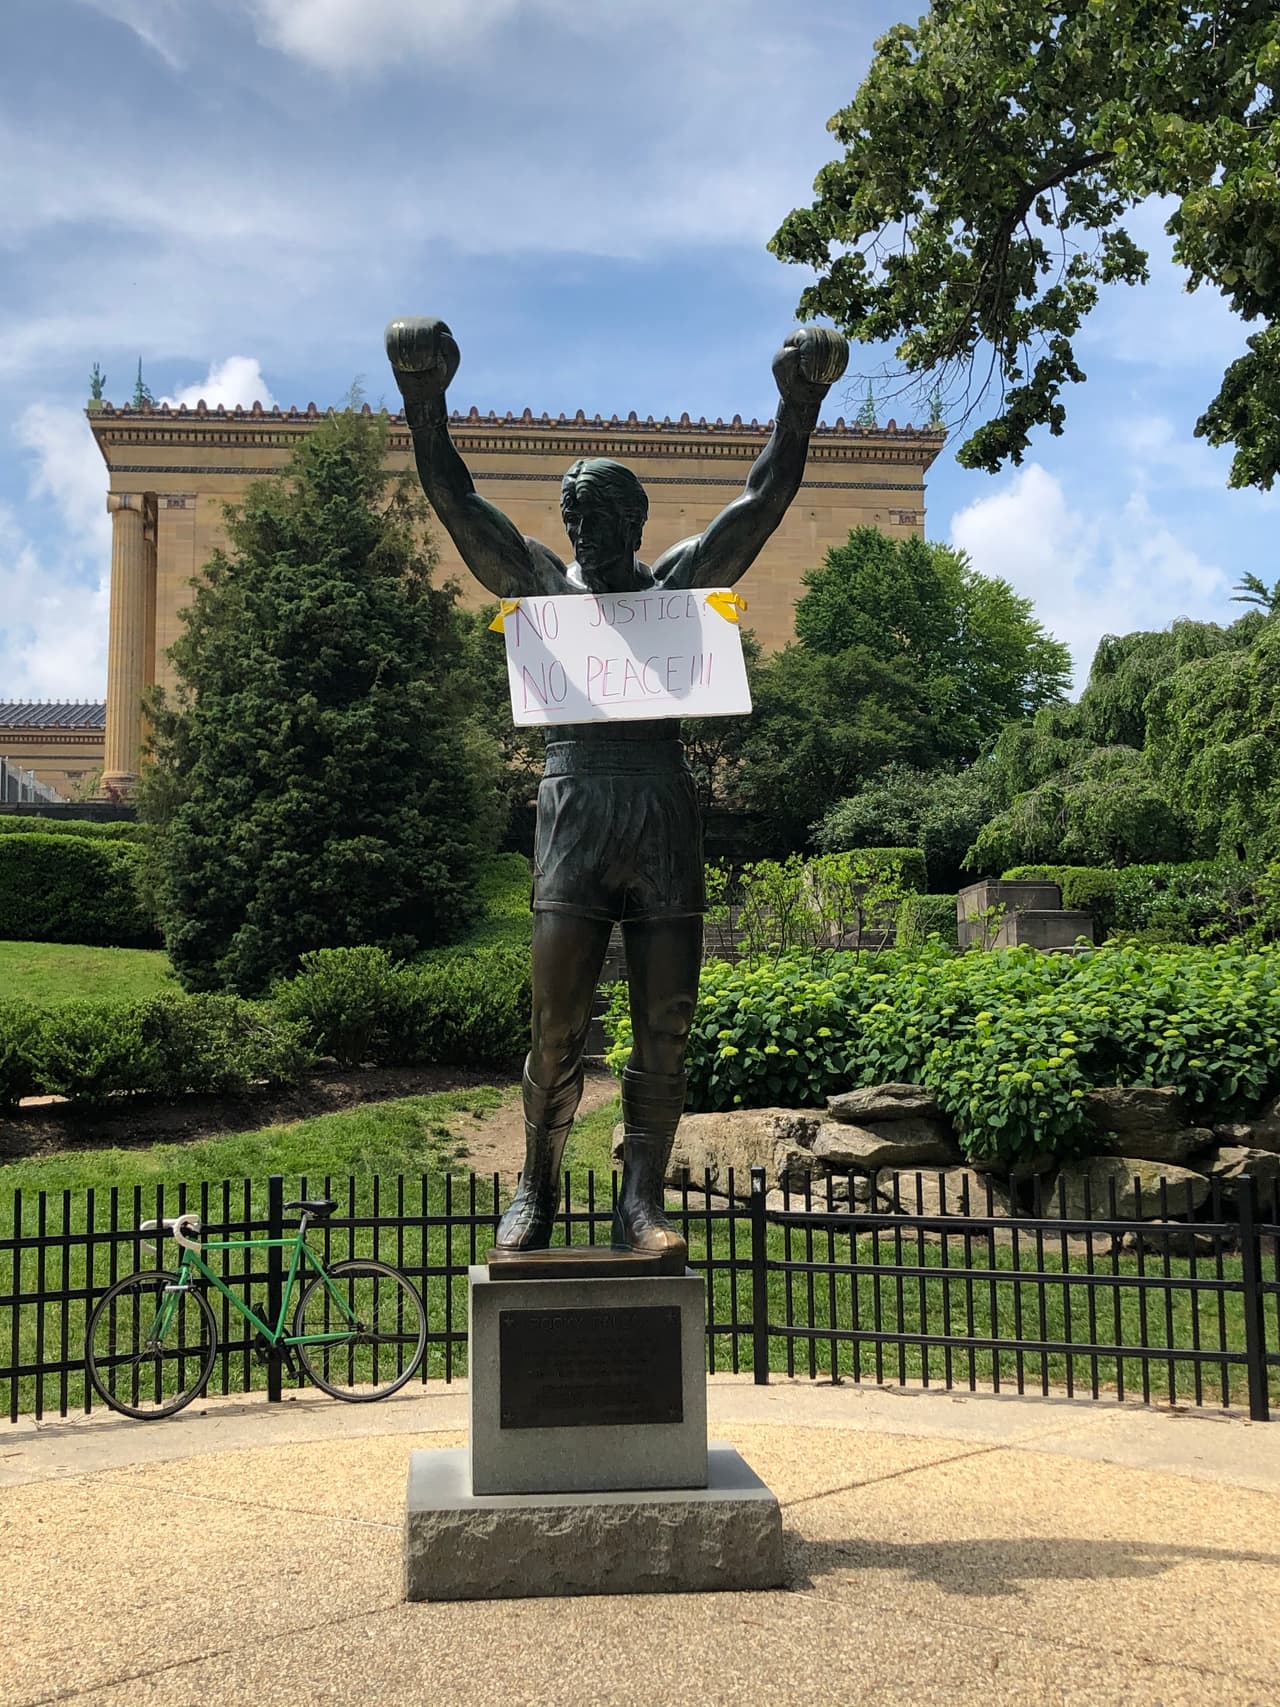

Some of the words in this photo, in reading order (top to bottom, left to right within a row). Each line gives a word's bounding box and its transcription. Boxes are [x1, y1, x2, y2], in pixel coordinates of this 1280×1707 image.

[515, 600, 559, 647] NO
[522, 660, 567, 709] NO
[587, 653, 713, 701] PEACE!!!
